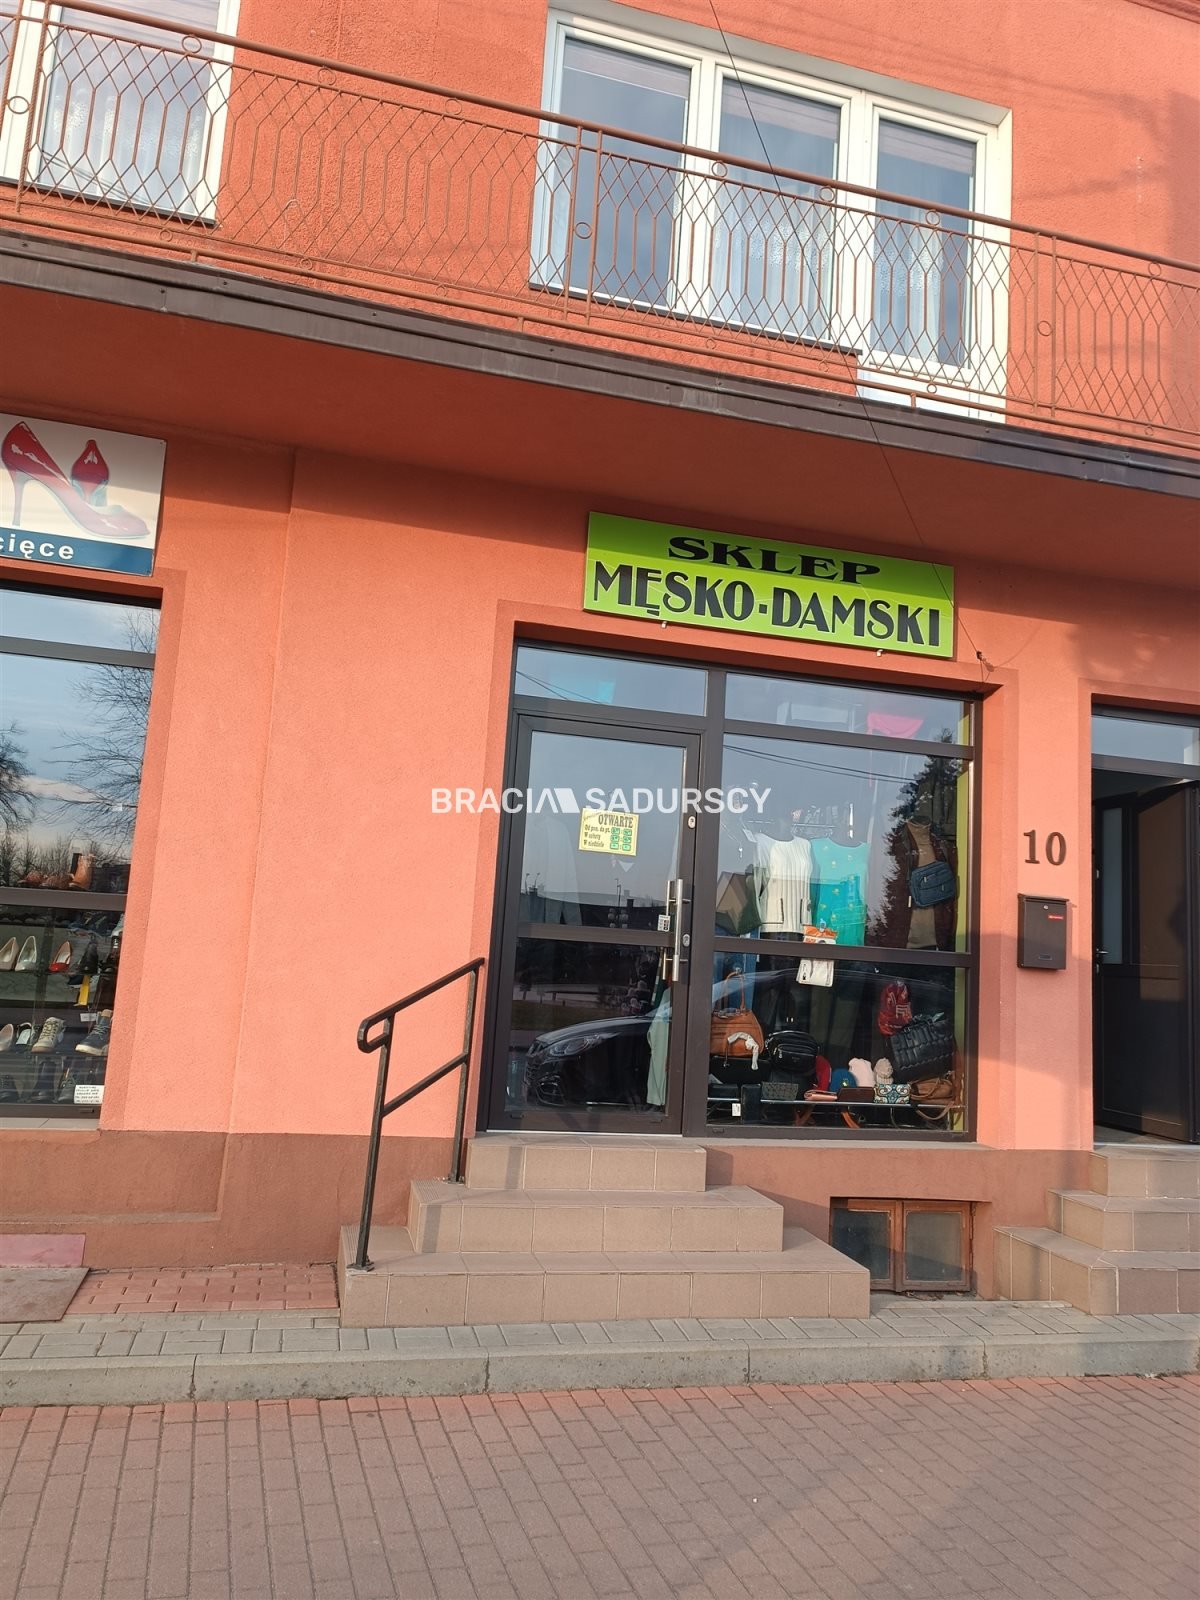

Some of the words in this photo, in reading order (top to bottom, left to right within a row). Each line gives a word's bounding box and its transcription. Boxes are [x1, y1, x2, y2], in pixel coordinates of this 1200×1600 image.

[0, 533, 74, 560] ięce
[667, 536, 881, 585] SKLEP
[593, 560, 940, 647] MĘSKO-DAMSKI
[598, 814, 634, 828] OTWARTE
[1023, 829, 1067, 867] 10
